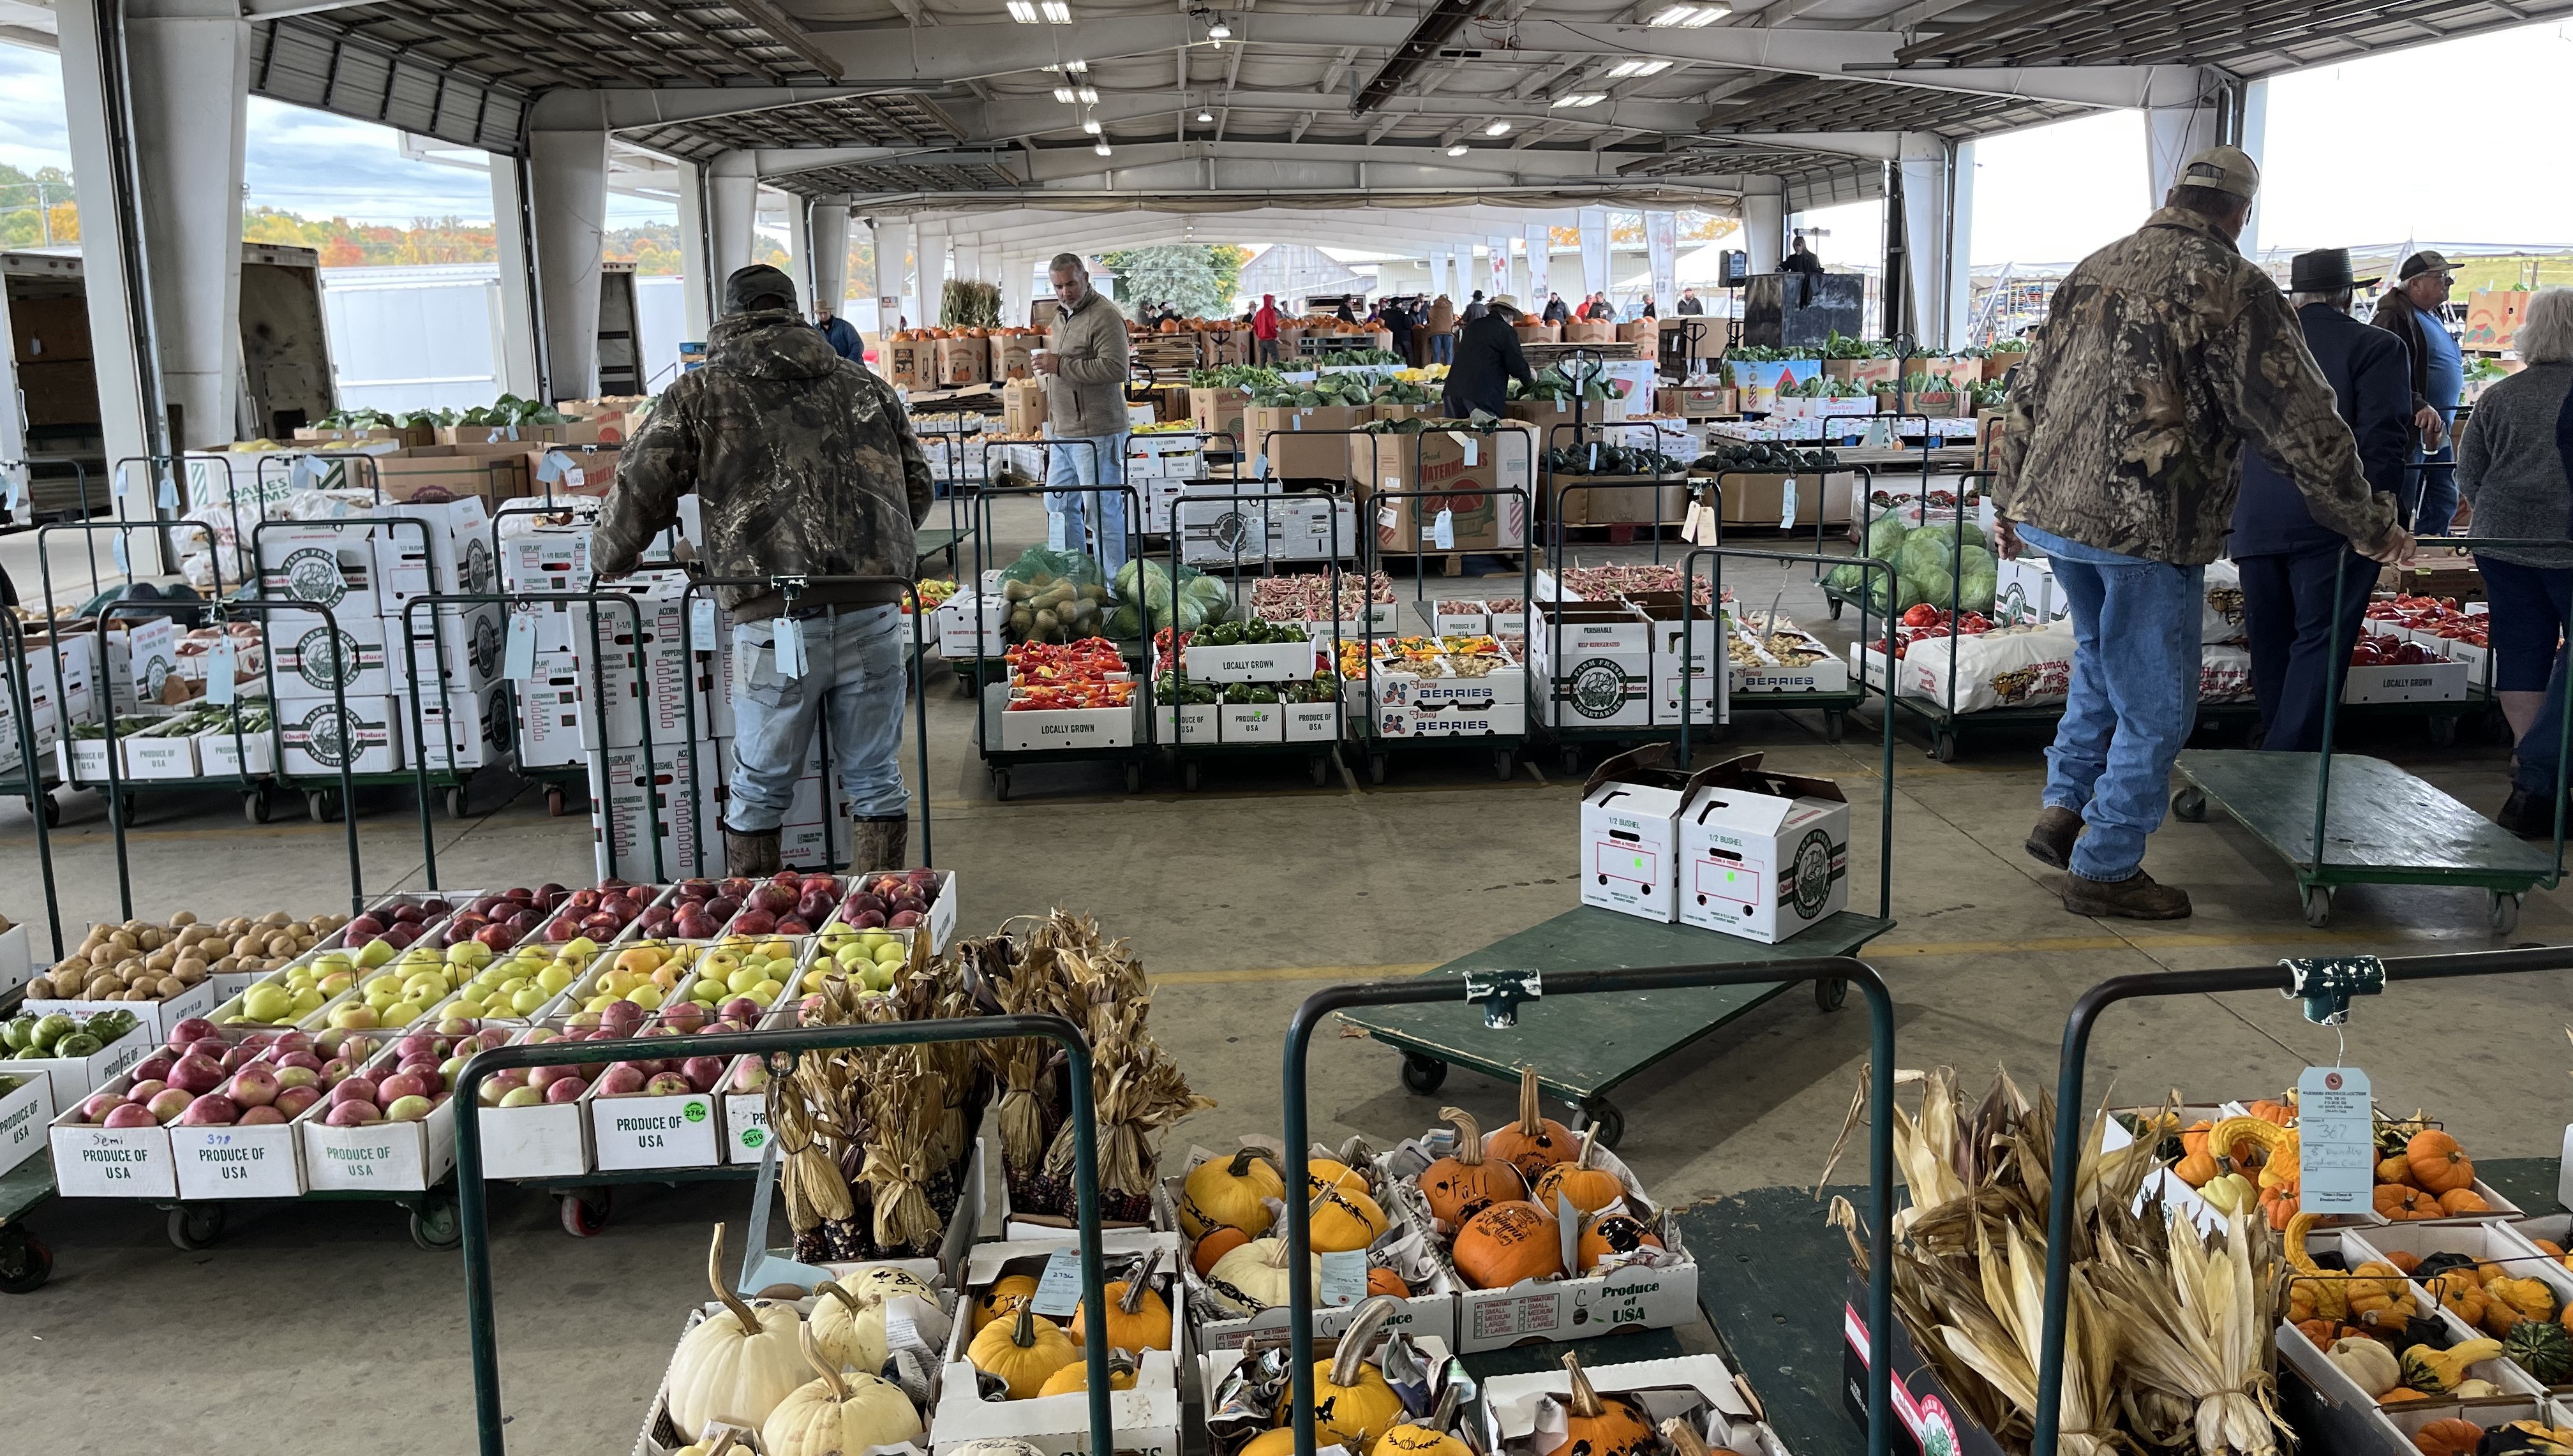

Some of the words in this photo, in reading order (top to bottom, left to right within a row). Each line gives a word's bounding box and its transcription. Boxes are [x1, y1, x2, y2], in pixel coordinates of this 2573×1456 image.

[1422, 450, 1441, 462] Fresh
[659, 607, 678, 615] ACORN
[1222, 661, 1250, 670] LOCALLY
[1252, 660, 1274, 669] GROWN
[1574, 660, 1596, 678] FARM
[1599, 660, 1624, 678] FRESH
[1736, 669, 1762, 678] Fancy
[2043, 672, 2069, 685] Gold
[1410, 679, 1437, 690] Fancy
[1745, 677, 1814, 686] BERRIES
[2383, 679, 2409, 687] LOCALLY
[2410, 678, 2433, 687] GROWN
[1420, 688, 1493, 699] BERRIES
[1574, 699, 1623, 718] VEGETABLES
[1235, 715, 1260, 723] PRODUCE
[1299, 714, 1324, 722] PRODUCE
[1409, 709, 1436, 720] Fancy
[1041, 725, 1070, 734] LOCALLY
[1071, 724, 1094, 733] GROWN
[1246, 724, 1259, 732] USA
[1309, 723, 1322, 731] USA
[1416, 720, 1488, 731] BERRIES
[73, 752, 97, 760] RODUCE
[140, 750, 166, 758] PRODUCE
[613, 796, 643, 804] CUCUMBERS
[1609, 817, 1618, 825] 1/2
[1619, 818, 1641, 829] BUSHEL
[1709, 833, 1719, 842] 1/2
[1720, 835, 1743, 847] BUSHEL
[131, 1047, 138, 1061] OF
[30, 1100, 38, 1115] OF
[616, 1117, 666, 1131] PRODUCE
[669, 1116, 682, 1128] OF
[13, 1127, 30, 1145] USA
[2316, 1124, 2346, 1139] 367
[93, 1133, 123, 1147] Semi
[638, 1134, 664, 1148] USA
[83, 1149, 131, 1162] PRODUCE
[135, 1148, 148, 1161] OF
[199, 1148, 250, 1161] PRODUCE
[252, 1147, 265, 1160] OF
[327, 1146, 375, 1160] PRODUCE
[377, 1145, 391, 1159] OF
[105, 1166, 131, 1180] USA
[221, 1166, 248, 1179] USA
[348, 1164, 374, 1177] USA
[1602, 1282, 1660, 1298] Produce
[1484, 1300, 1512, 1308] TOMATOES
[1526, 1295, 1555, 1304] TOMATOES
[1623, 1296, 1636, 1305] of
[1484, 1313, 1511, 1322] MEDIUM
[1527, 1308, 1554, 1316] MEDIUM
[1613, 1307, 1646, 1323] USA
[1532, 1320, 1555, 1328] LARGE
[1225, 1331, 1256, 1340] TOMATOES
[1490, 1326, 1512, 1334] LARGE
[1921, 1399, 1938, 1416] FARM
